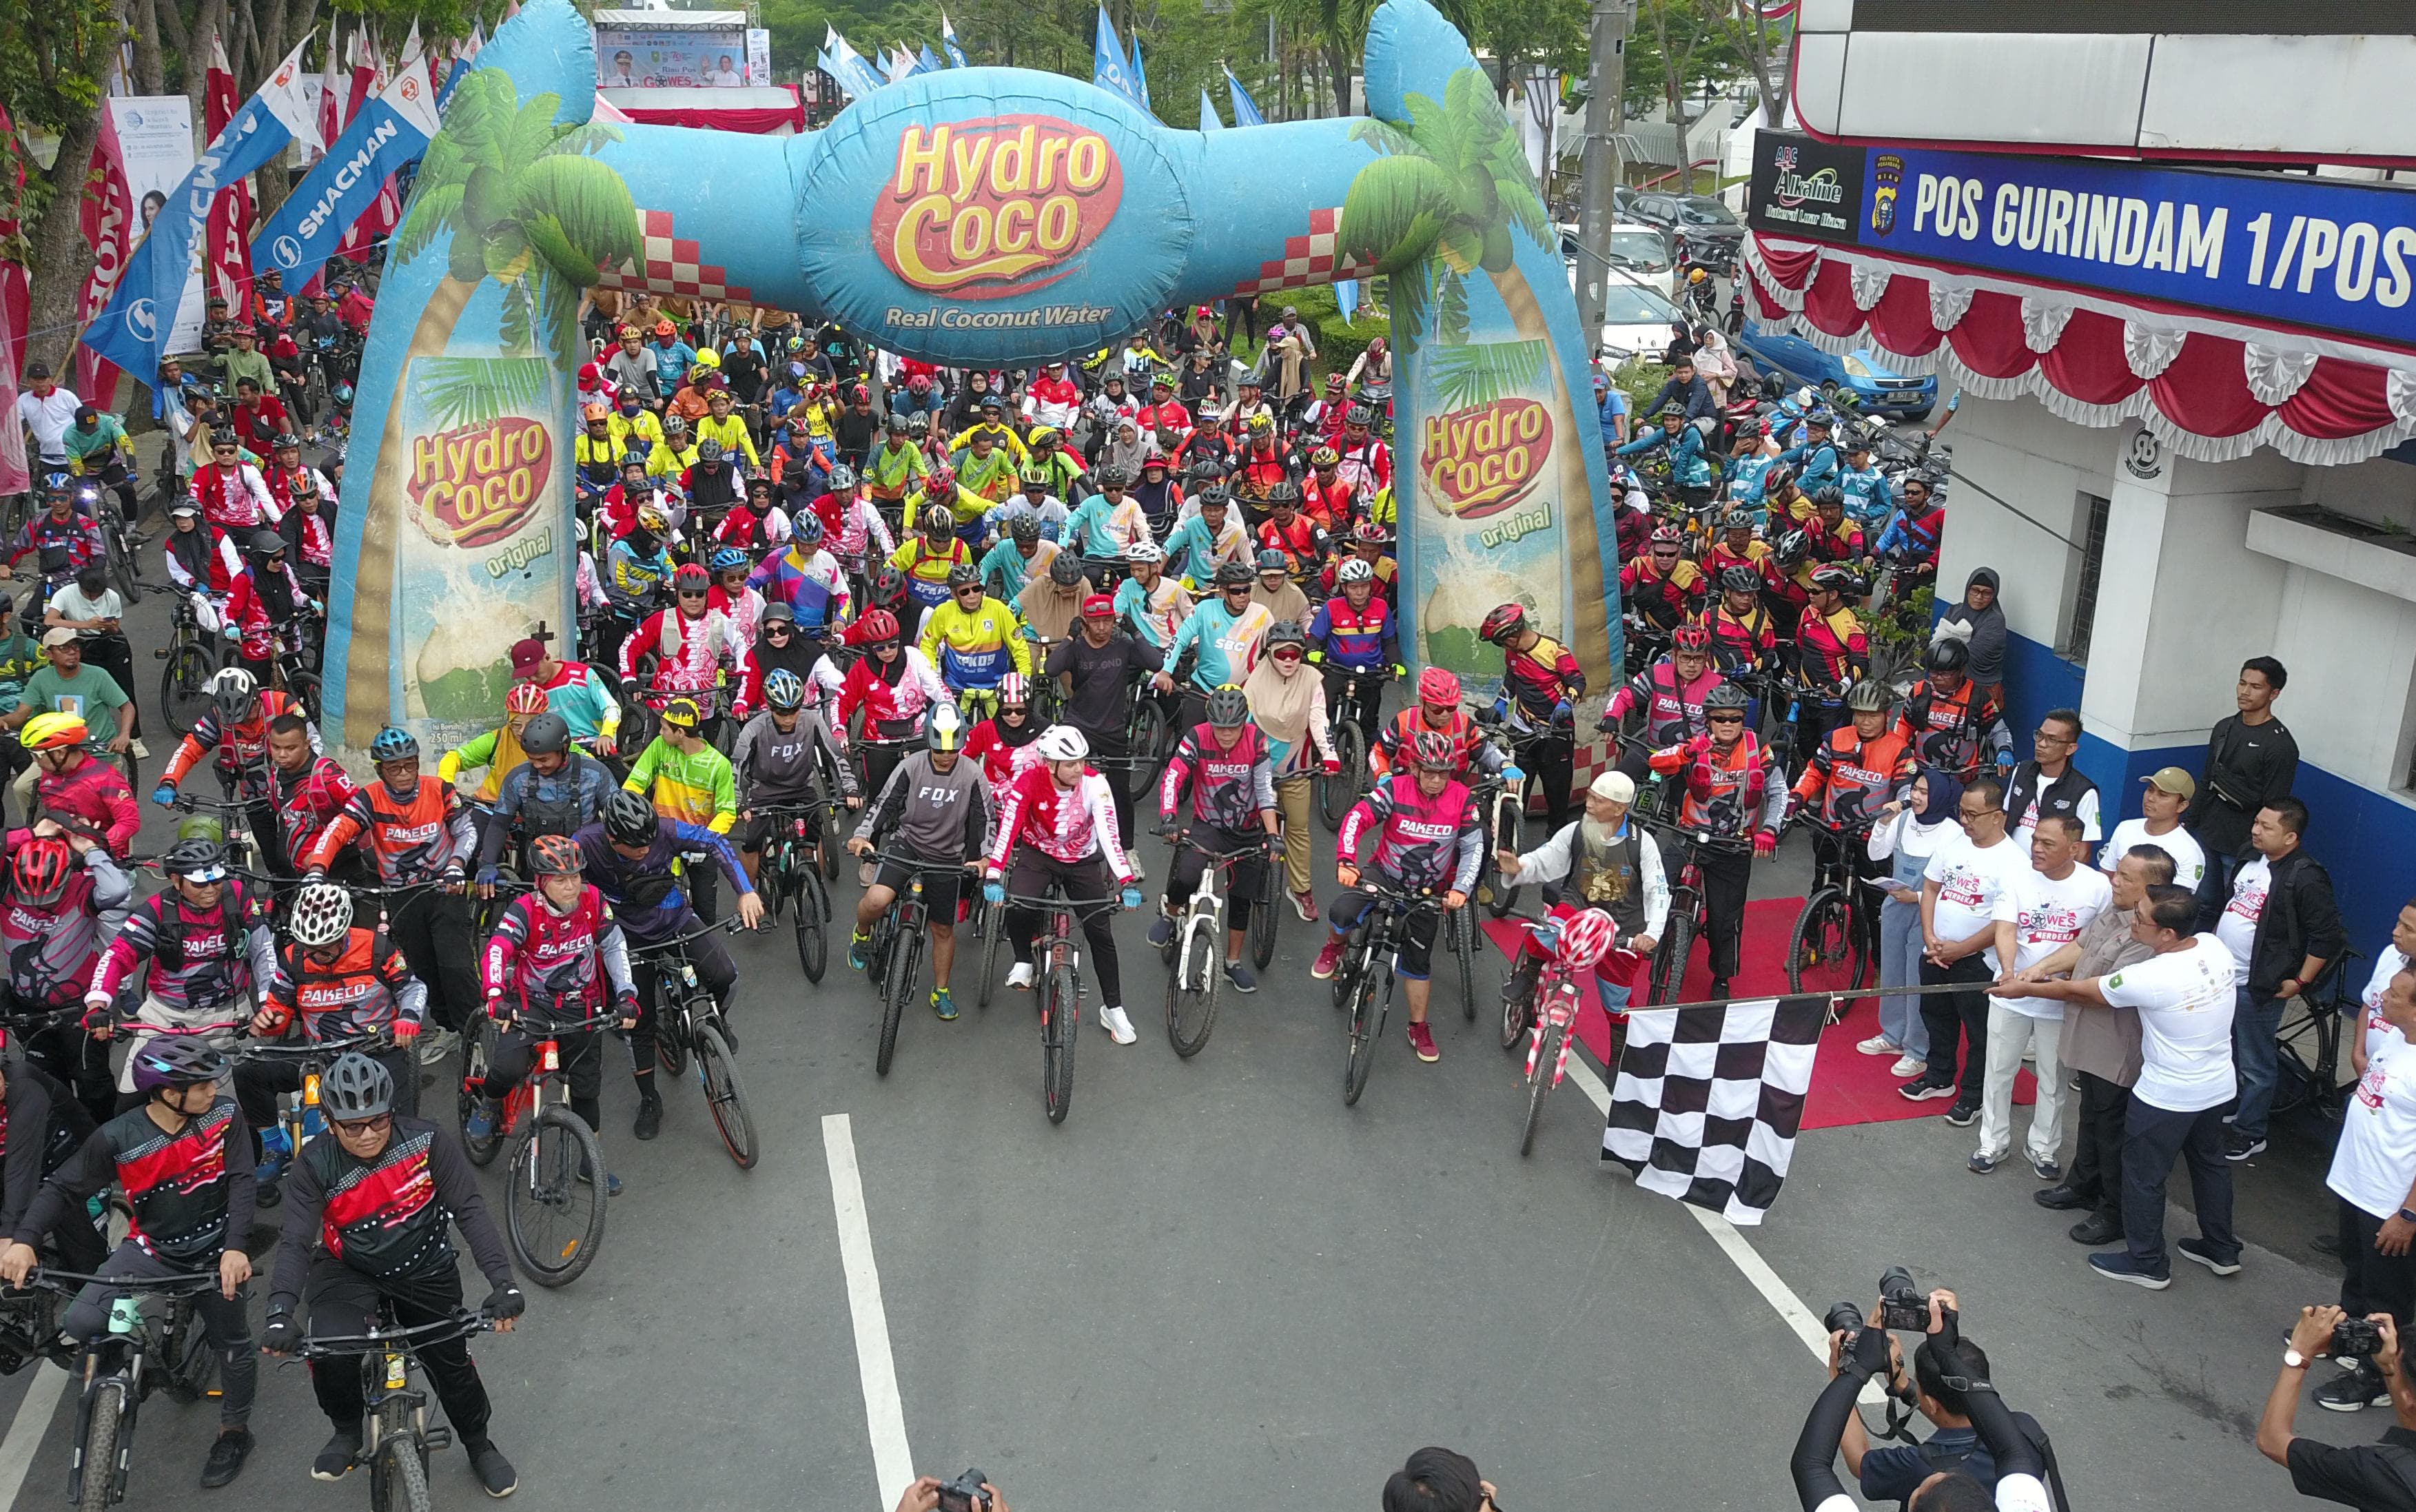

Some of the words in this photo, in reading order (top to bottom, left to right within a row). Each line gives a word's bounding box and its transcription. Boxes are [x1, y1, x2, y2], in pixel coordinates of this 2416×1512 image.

[897, 125, 1107, 203] Hydro
[1775, 146, 1798, 163] ABC
[298, 119, 398, 239] SHACMAN
[1774, 168, 1843, 204] Alkaline
[1914, 173, 1983, 241] POS
[1992, 182, 2228, 281] GURINDAM
[2246, 213, 2416, 309] 1/POS
[885, 307, 936, 327] Real
[941, 307, 1041, 329] Coconut
[1044, 306, 1112, 326] Water
[1426, 402, 1544, 461] Hydro
[416, 423, 544, 486] Hydro
[1480, 502, 1551, 549] Original
[486, 527, 552, 580] Original
[1215, 638, 1246, 652] SBC
[430, 733, 448, 743] 250
[450, 733, 462, 743] ml
[771, 742, 803, 757] FOX
[1836, 765, 1883, 784] PAKECO
[919, 786, 959, 802] FOX
[387, 821, 437, 839] PAKECO
[991, 797, 1019, 861] INDONESIA
[1400, 819, 1453, 836] PAKECO
[538, 933, 593, 955] PAKECO
[2035, 930, 2075, 941] MERDEKA
[301, 983, 366, 1003] PAKECO
